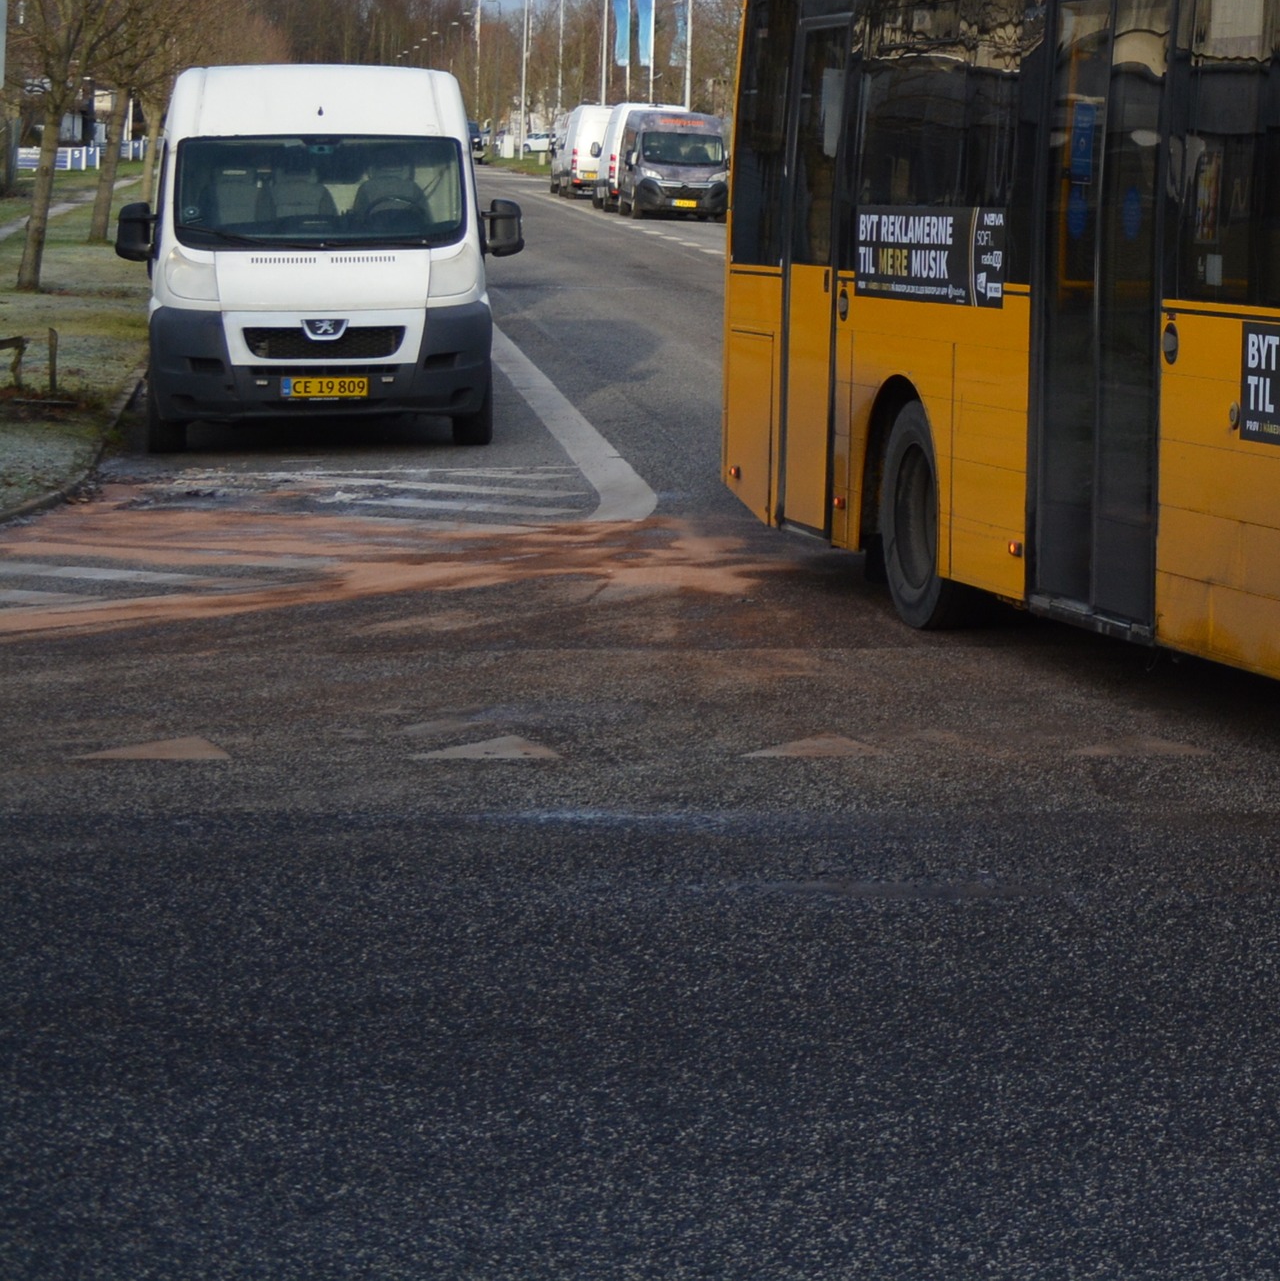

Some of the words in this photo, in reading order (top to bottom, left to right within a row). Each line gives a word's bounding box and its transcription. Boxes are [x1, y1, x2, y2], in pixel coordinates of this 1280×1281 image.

[859, 214, 879, 242] BYT
[881, 215, 954, 245] REKLAMERNE
[858, 247, 875, 274] TIL
[878, 248, 909, 277] MERE
[911, 249, 949, 279] MUSIK
[1247, 333, 1280, 372] BYT
[292, 380, 312, 394] CE
[317, 380, 335, 394] 19
[338, 380, 367, 394] 809
[1247, 375, 1275, 414] TIL
